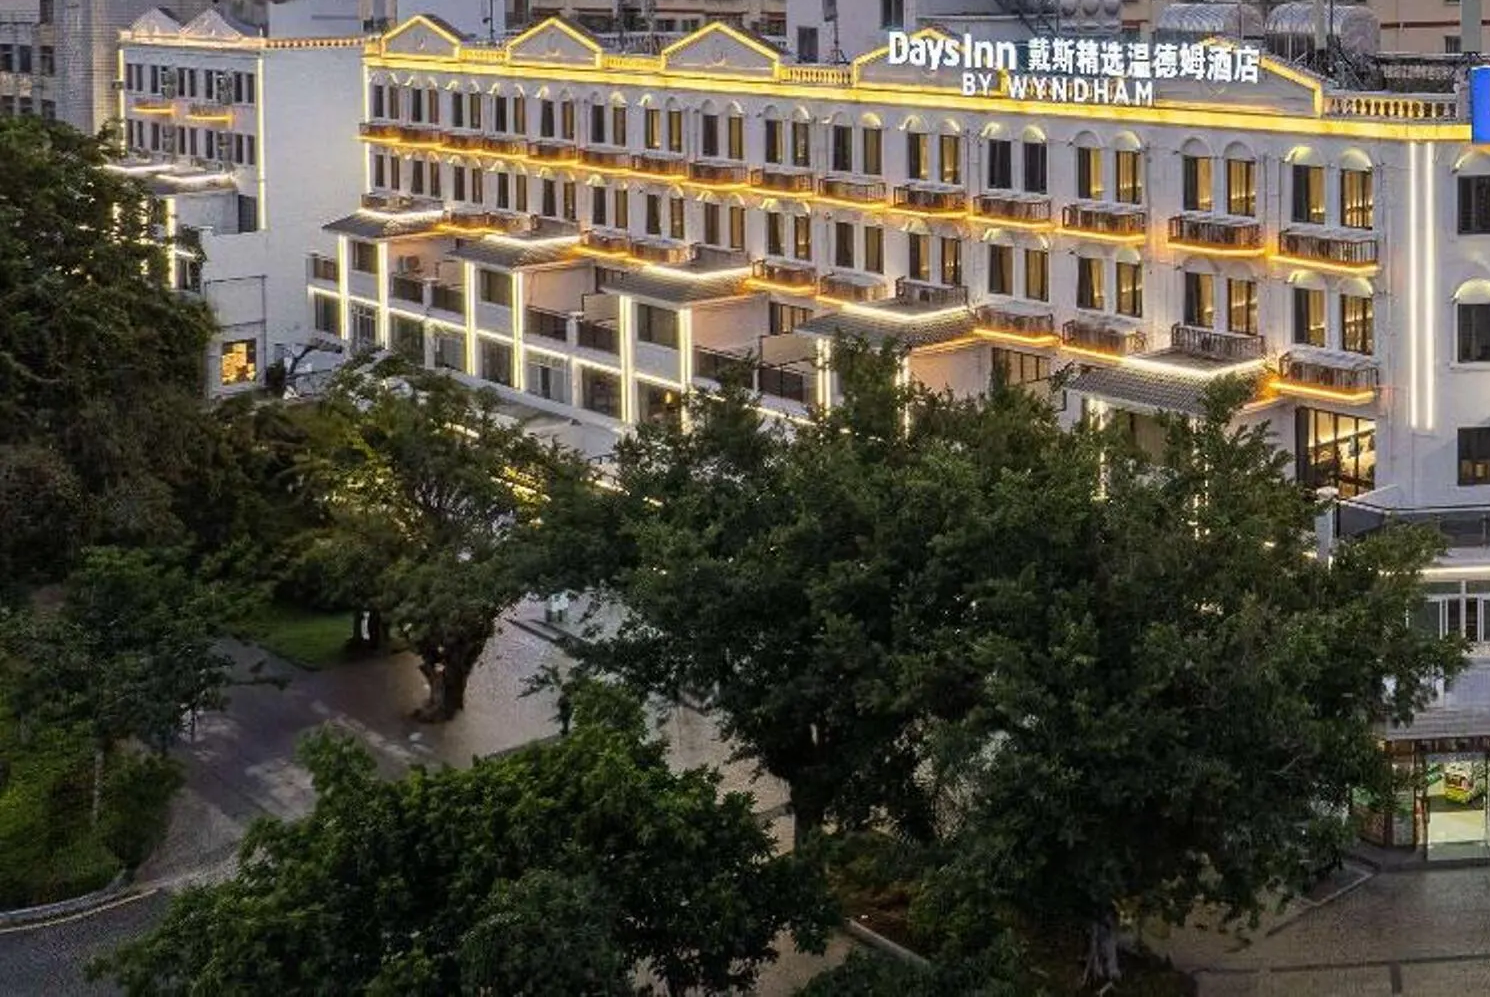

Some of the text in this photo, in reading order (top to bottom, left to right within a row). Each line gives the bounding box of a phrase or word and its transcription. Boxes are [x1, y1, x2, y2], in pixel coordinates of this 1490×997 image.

[1028, 38, 1260, 83] 戴斯精选温德姆酒店
[962, 73, 1154, 107] BY WYNDHAM
